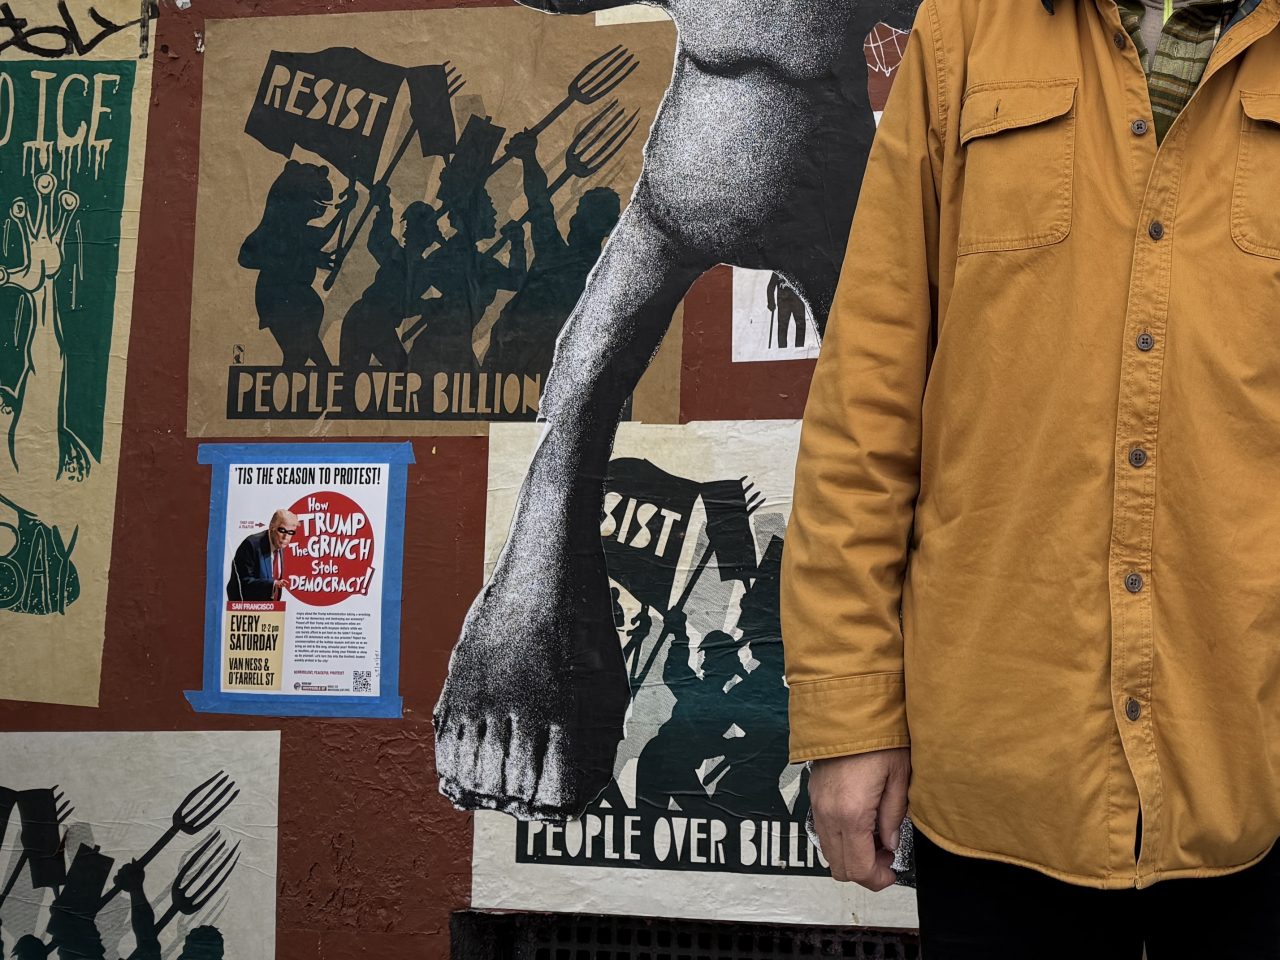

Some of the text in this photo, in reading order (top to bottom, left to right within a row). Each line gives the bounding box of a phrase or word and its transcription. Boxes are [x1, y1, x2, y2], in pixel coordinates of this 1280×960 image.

[23, 70, 121, 150] ICE
[263, 64, 389, 138] RESIST
[237, 371, 541, 414] PEOPLE OVER BILLION
[235, 467, 381, 485] 'TIS THE SEASON TO PROTEST!
[308, 497, 329, 512] How
[297, 512, 366, 537] TRUMP
[600, 491, 682, 558] SIST
[289, 535, 371, 561] The GRINCH
[311, 559, 338, 575] Stole
[288, 567, 374, 596] DEMOCRACY!
[231, 615, 260, 632] EVERY
[229, 634, 278, 651] SATURDAY
[229, 658, 269, 671] VAN NESS &
[228, 672, 275, 686] O'FARRELL ST
[527, 814, 830, 869] PEOPLE OVER BILLI
